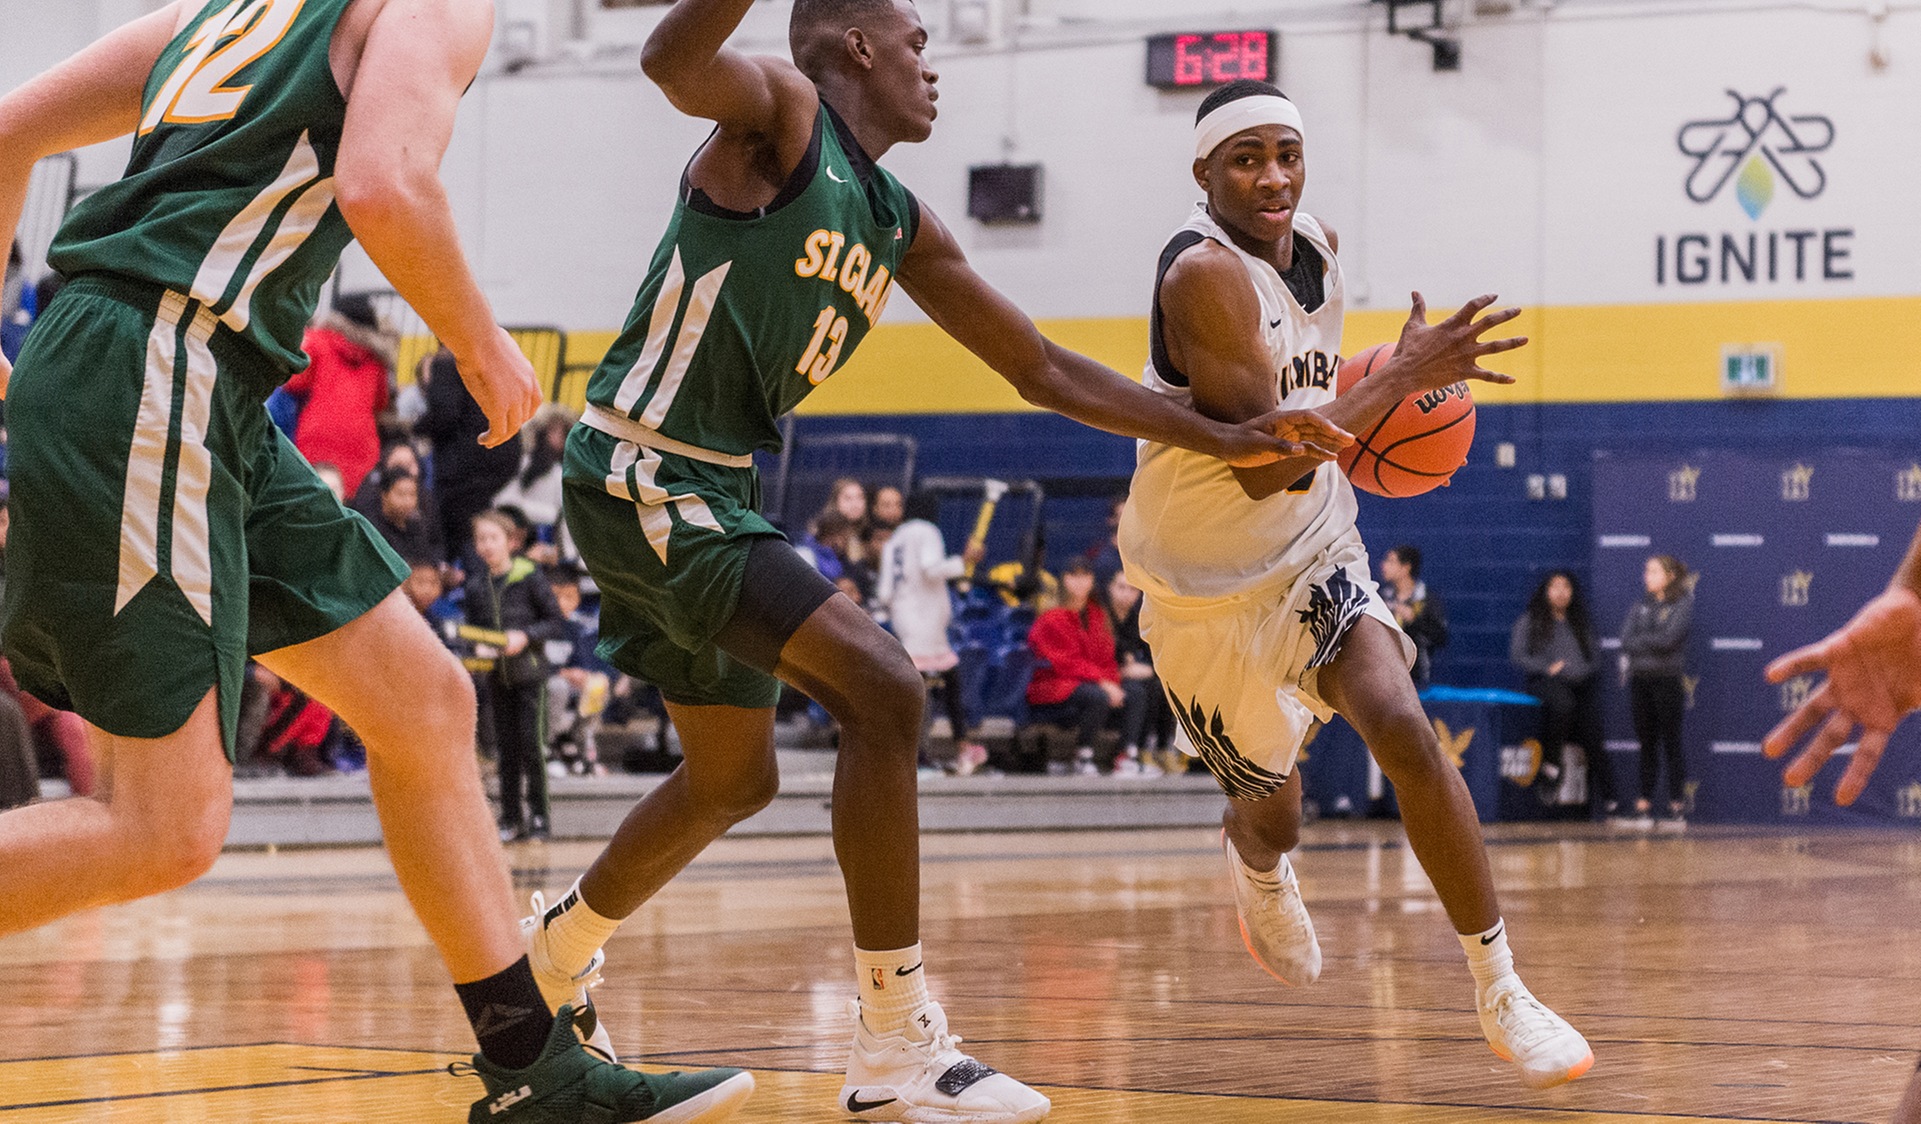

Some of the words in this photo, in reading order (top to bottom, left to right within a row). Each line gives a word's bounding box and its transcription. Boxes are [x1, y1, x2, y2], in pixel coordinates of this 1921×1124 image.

[138, 0, 306, 138] 12
[1174, 31, 1268, 85] 6:28
[839, 243, 894, 328] CLA
[1657, 229, 1854, 285] IGNITE
[795, 305, 849, 386] 13
